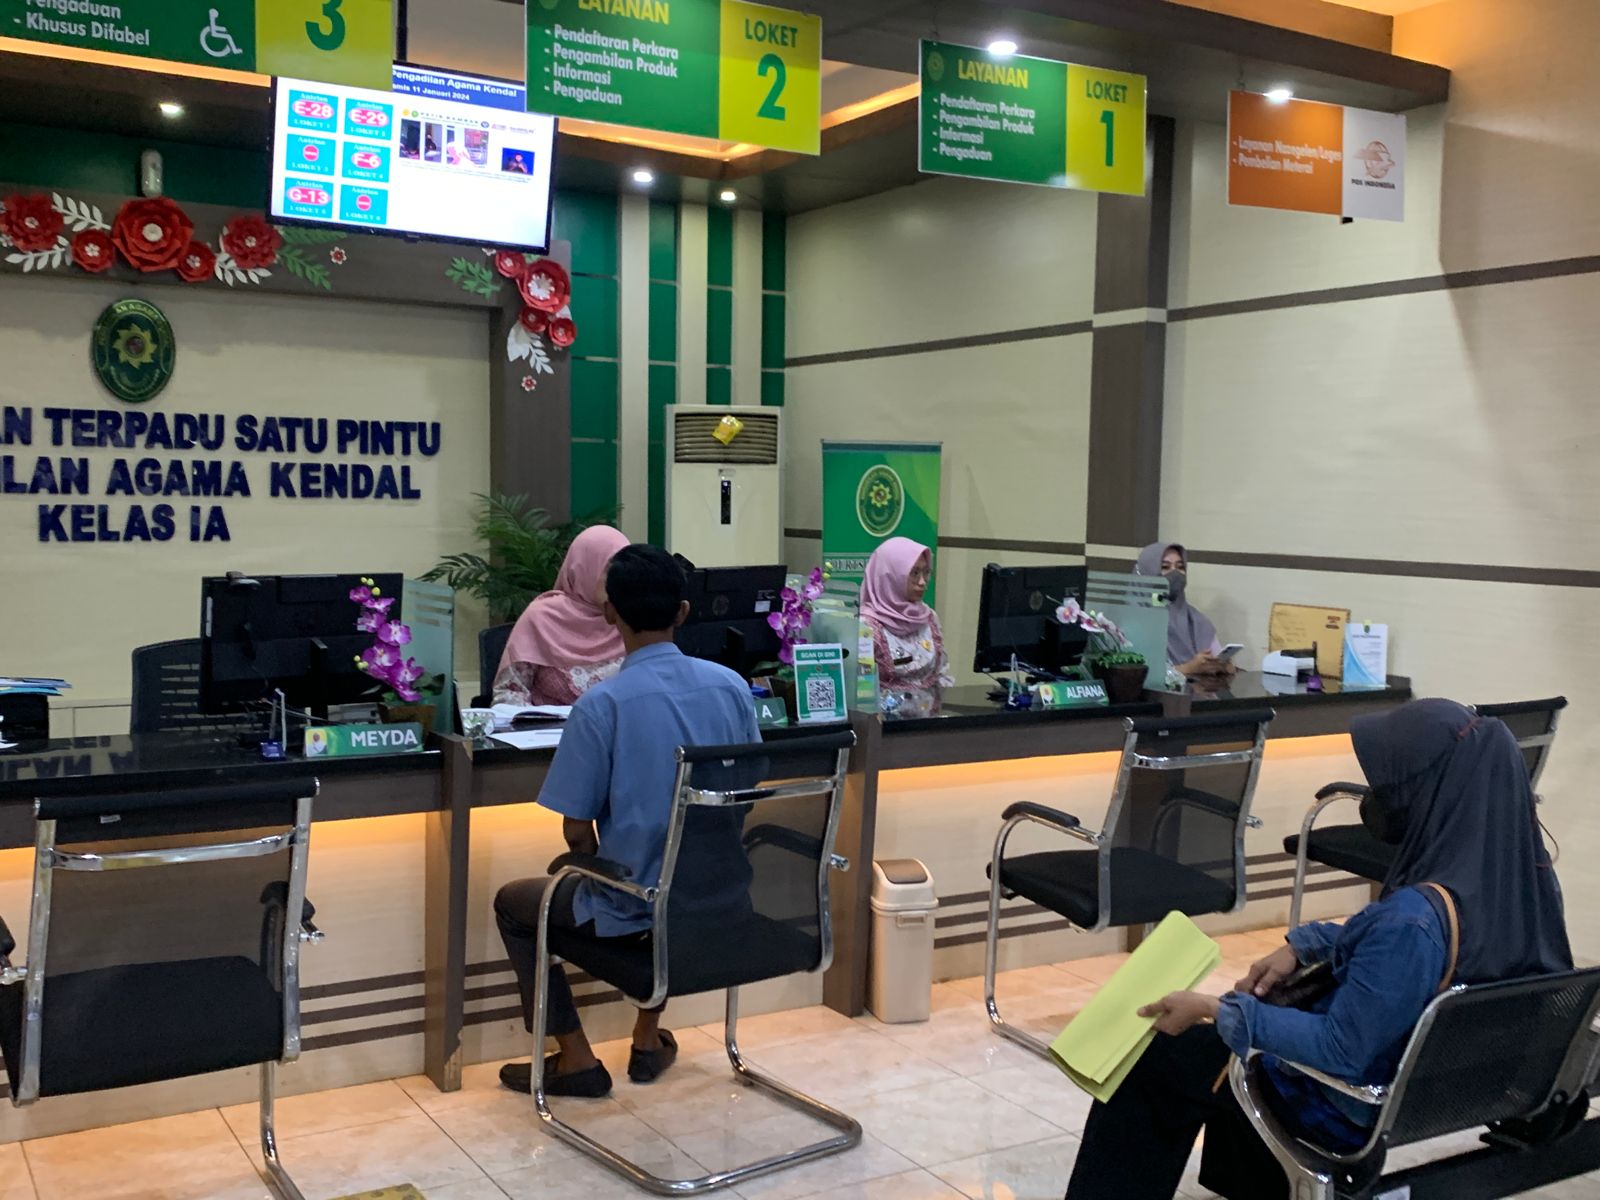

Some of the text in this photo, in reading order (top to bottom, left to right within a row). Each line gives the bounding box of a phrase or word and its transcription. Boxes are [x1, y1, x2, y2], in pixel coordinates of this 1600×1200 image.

[26, 12, 151, 46] Khusus Difabel
[305, 0, 346, 51] 3
[744, 18, 799, 48] LOKET
[553, 24, 679, 60] Pendaftaran Perkara
[552, 43, 678, 78] Pengambilan Produk
[552, 63, 611, 85] Informasi
[757, 53, 787, 121] 2
[958, 59, 1029, 89] LAYANAN
[422, 87, 451, 98] Januari
[452, 92, 470, 101] 2024
[447, 78, 482, 93] Agama
[483, 84, 518, 98] Kendal
[552, 82, 622, 105] Pengaduan
[1086, 79, 1128, 103] LOKET
[293, 100, 333, 118] E-28
[350, 109, 388, 126] E-29
[940, 93, 1035, 119] Pendaftaran Perkara
[939, 110, 1035, 136] Pengambilan Produk
[939, 127, 984, 145] Informasi
[939, 142, 993, 161] Pengaduan
[1100, 110, 1114, 167] 1
[288, 188, 330, 205] G-13
[43, 407, 226, 451] TERPADU
[234, 413, 328, 453] SATU
[337, 418, 442, 457] PINTU
[0, 455, 422, 500] LAN AGAMA KENDAL
[38, 504, 231, 542] KELAS IA
[1066, 684, 1105, 699] ALFIANA
[350, 728, 419, 748] MEYDA
